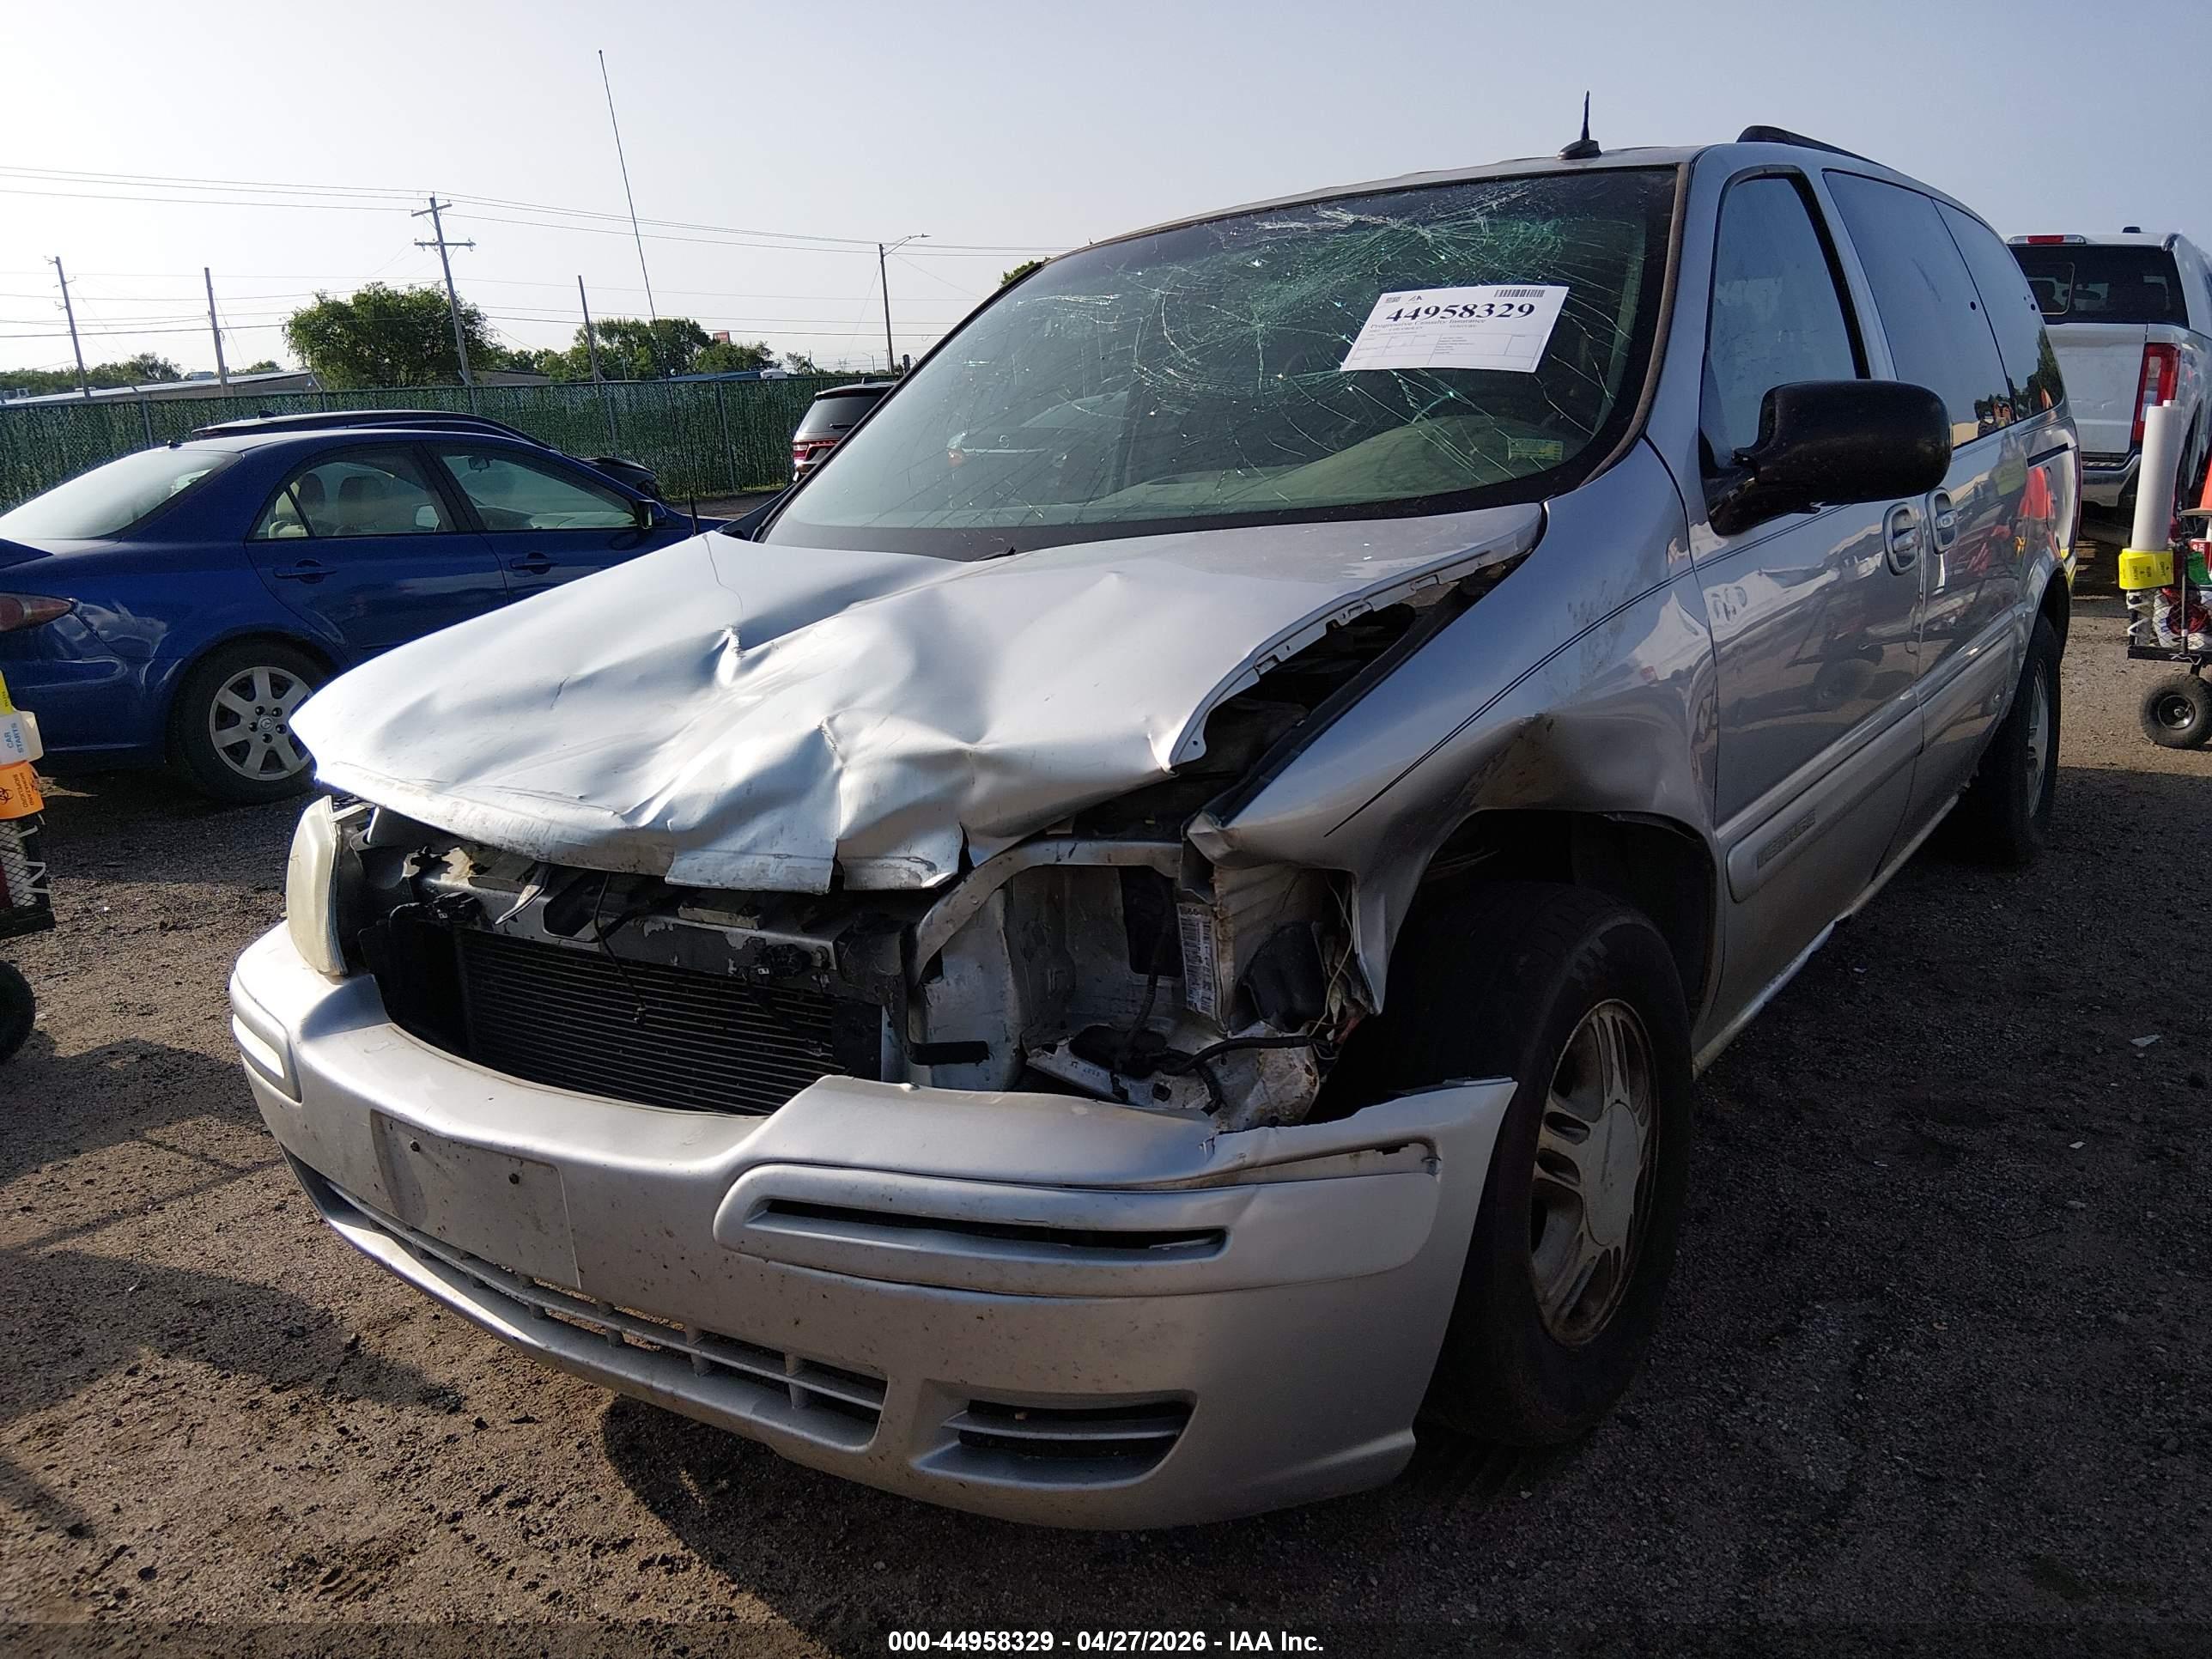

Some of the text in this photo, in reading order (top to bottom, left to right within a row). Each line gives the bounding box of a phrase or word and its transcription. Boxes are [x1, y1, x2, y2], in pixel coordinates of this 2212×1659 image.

[1385, 303, 1535, 322] 44958329
[4, 732, 13, 749] CAR
[11, 723, 23, 753] STARTS
